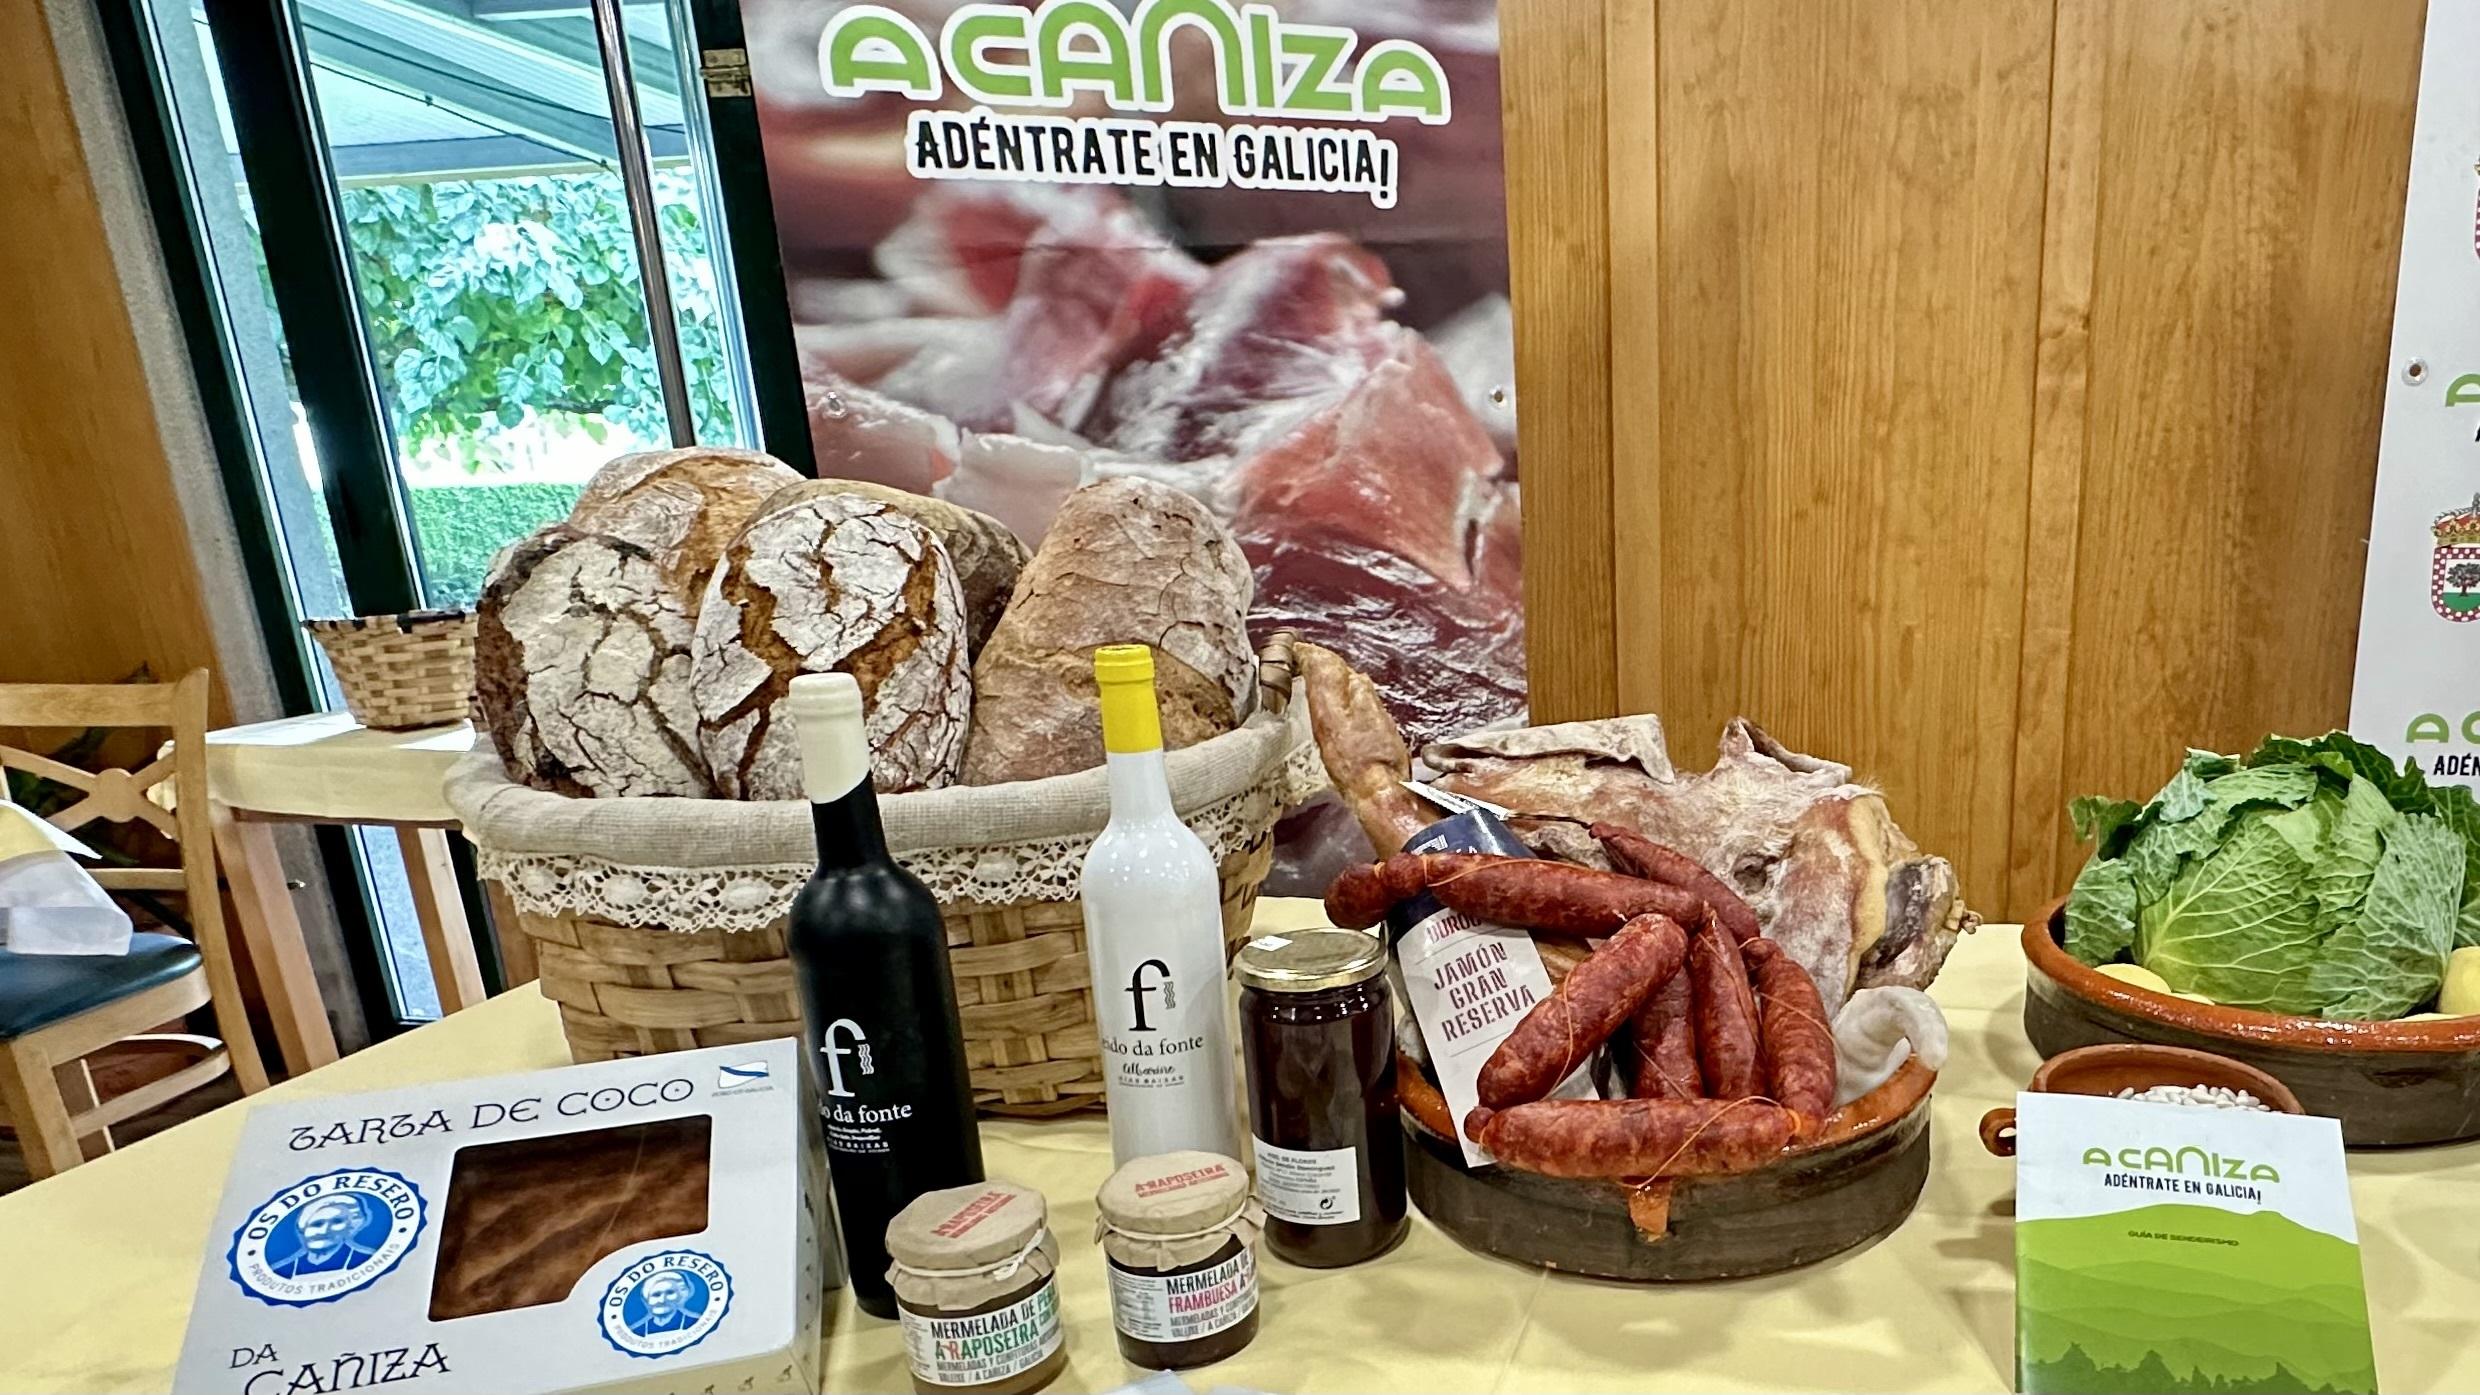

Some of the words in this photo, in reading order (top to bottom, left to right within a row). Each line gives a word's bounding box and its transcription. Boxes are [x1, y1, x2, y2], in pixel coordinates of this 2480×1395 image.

[830, 15, 932, 91] A
[916, 116, 1156, 177] ADÉNTRATE
[1170, 132, 1218, 179] EN
[1234, 134, 1390, 200] GALICIA!
[2405, 713, 2449, 743] A
[1434, 942, 1508, 990] JAMÓN
[1449, 967, 1508, 1010] GRAN
[1441, 984, 1536, 1042] RESERVA
[1133, 1040, 1153, 1056] da
[1160, 1036, 1204, 1056] fonte
[288, 1109, 454, 1151] TARTA
[471, 1098, 542, 1130] DE
[557, 1078, 695, 1116] COCO
[833, 1104, 854, 1123] da
[858, 1104, 913, 1123] fonte
[2083, 1147, 2112, 1167] A
[248, 1212, 280, 1241] OS
[278, 1183, 321, 1210] DO
[332, 1174, 415, 1221] RESERO
[2104, 1172, 2180, 1193] ADÉNTRATE
[2184, 1180, 2201, 1195] EN
[2206, 1182, 2262, 1205] GALICIA!
[2154, 1232, 2168, 1241] DE
[309, 1242, 401, 1295] TRADICIONAIS
[609, 1285, 629, 1308] OS
[626, 1262, 655, 1283] DO
[663, 1255, 724, 1292] RESERO
[1166, 1258, 1240, 1295] MERMELADA
[1168, 1279, 1238, 1314] FRAMBUESA
[930, 1308, 1019, 1340] MERMELADA
[1020, 1298, 1036, 1318] DE
[229, 1343, 279, 1369] DA
[944, 1320, 1040, 1361] RAPOSEIRA
